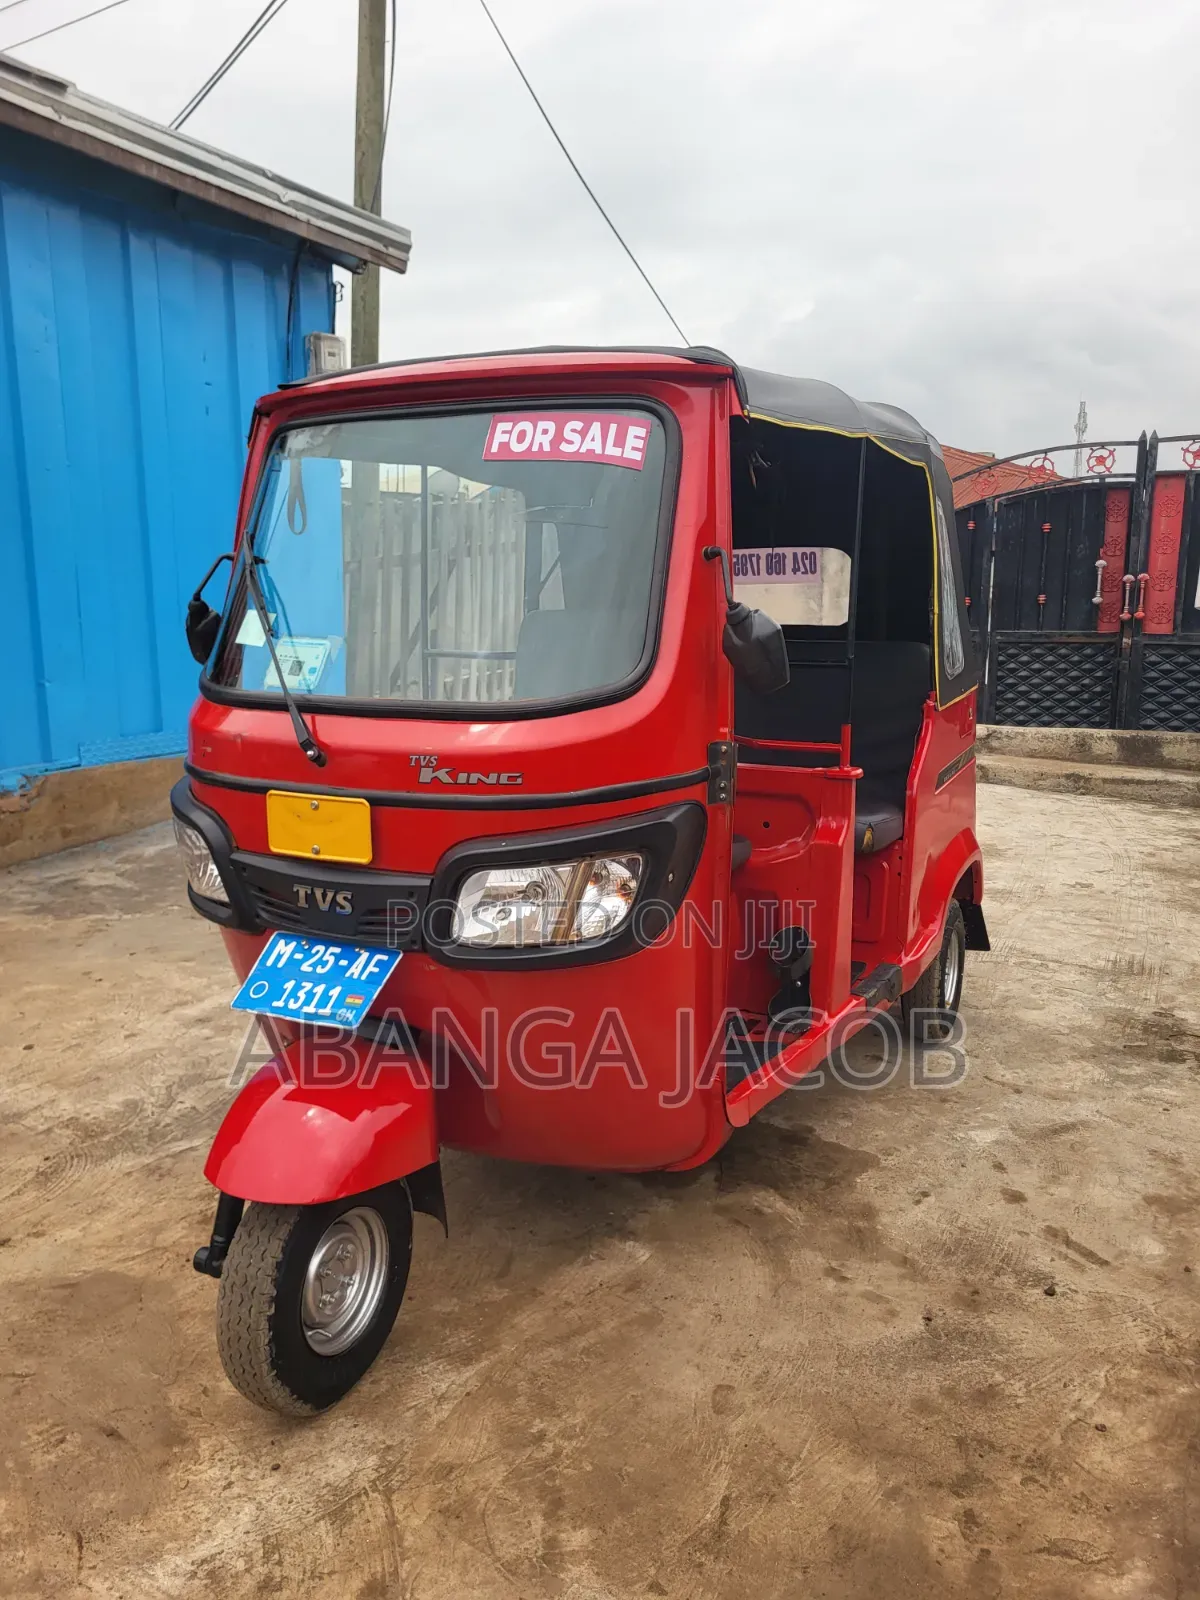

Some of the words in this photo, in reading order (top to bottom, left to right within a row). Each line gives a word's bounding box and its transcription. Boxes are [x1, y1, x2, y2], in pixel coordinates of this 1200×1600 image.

[491, 420, 556, 453] FOR
[559, 420, 647, 460] SALE
[409, 755, 438, 767] TVS
[418, 767, 524, 785] KING
[293, 884, 353, 915] TVS
[265, 938, 389, 981] M-25-AF
[271, 979, 343, 1016] 1311
[335, 1007, 356, 1022] GH
